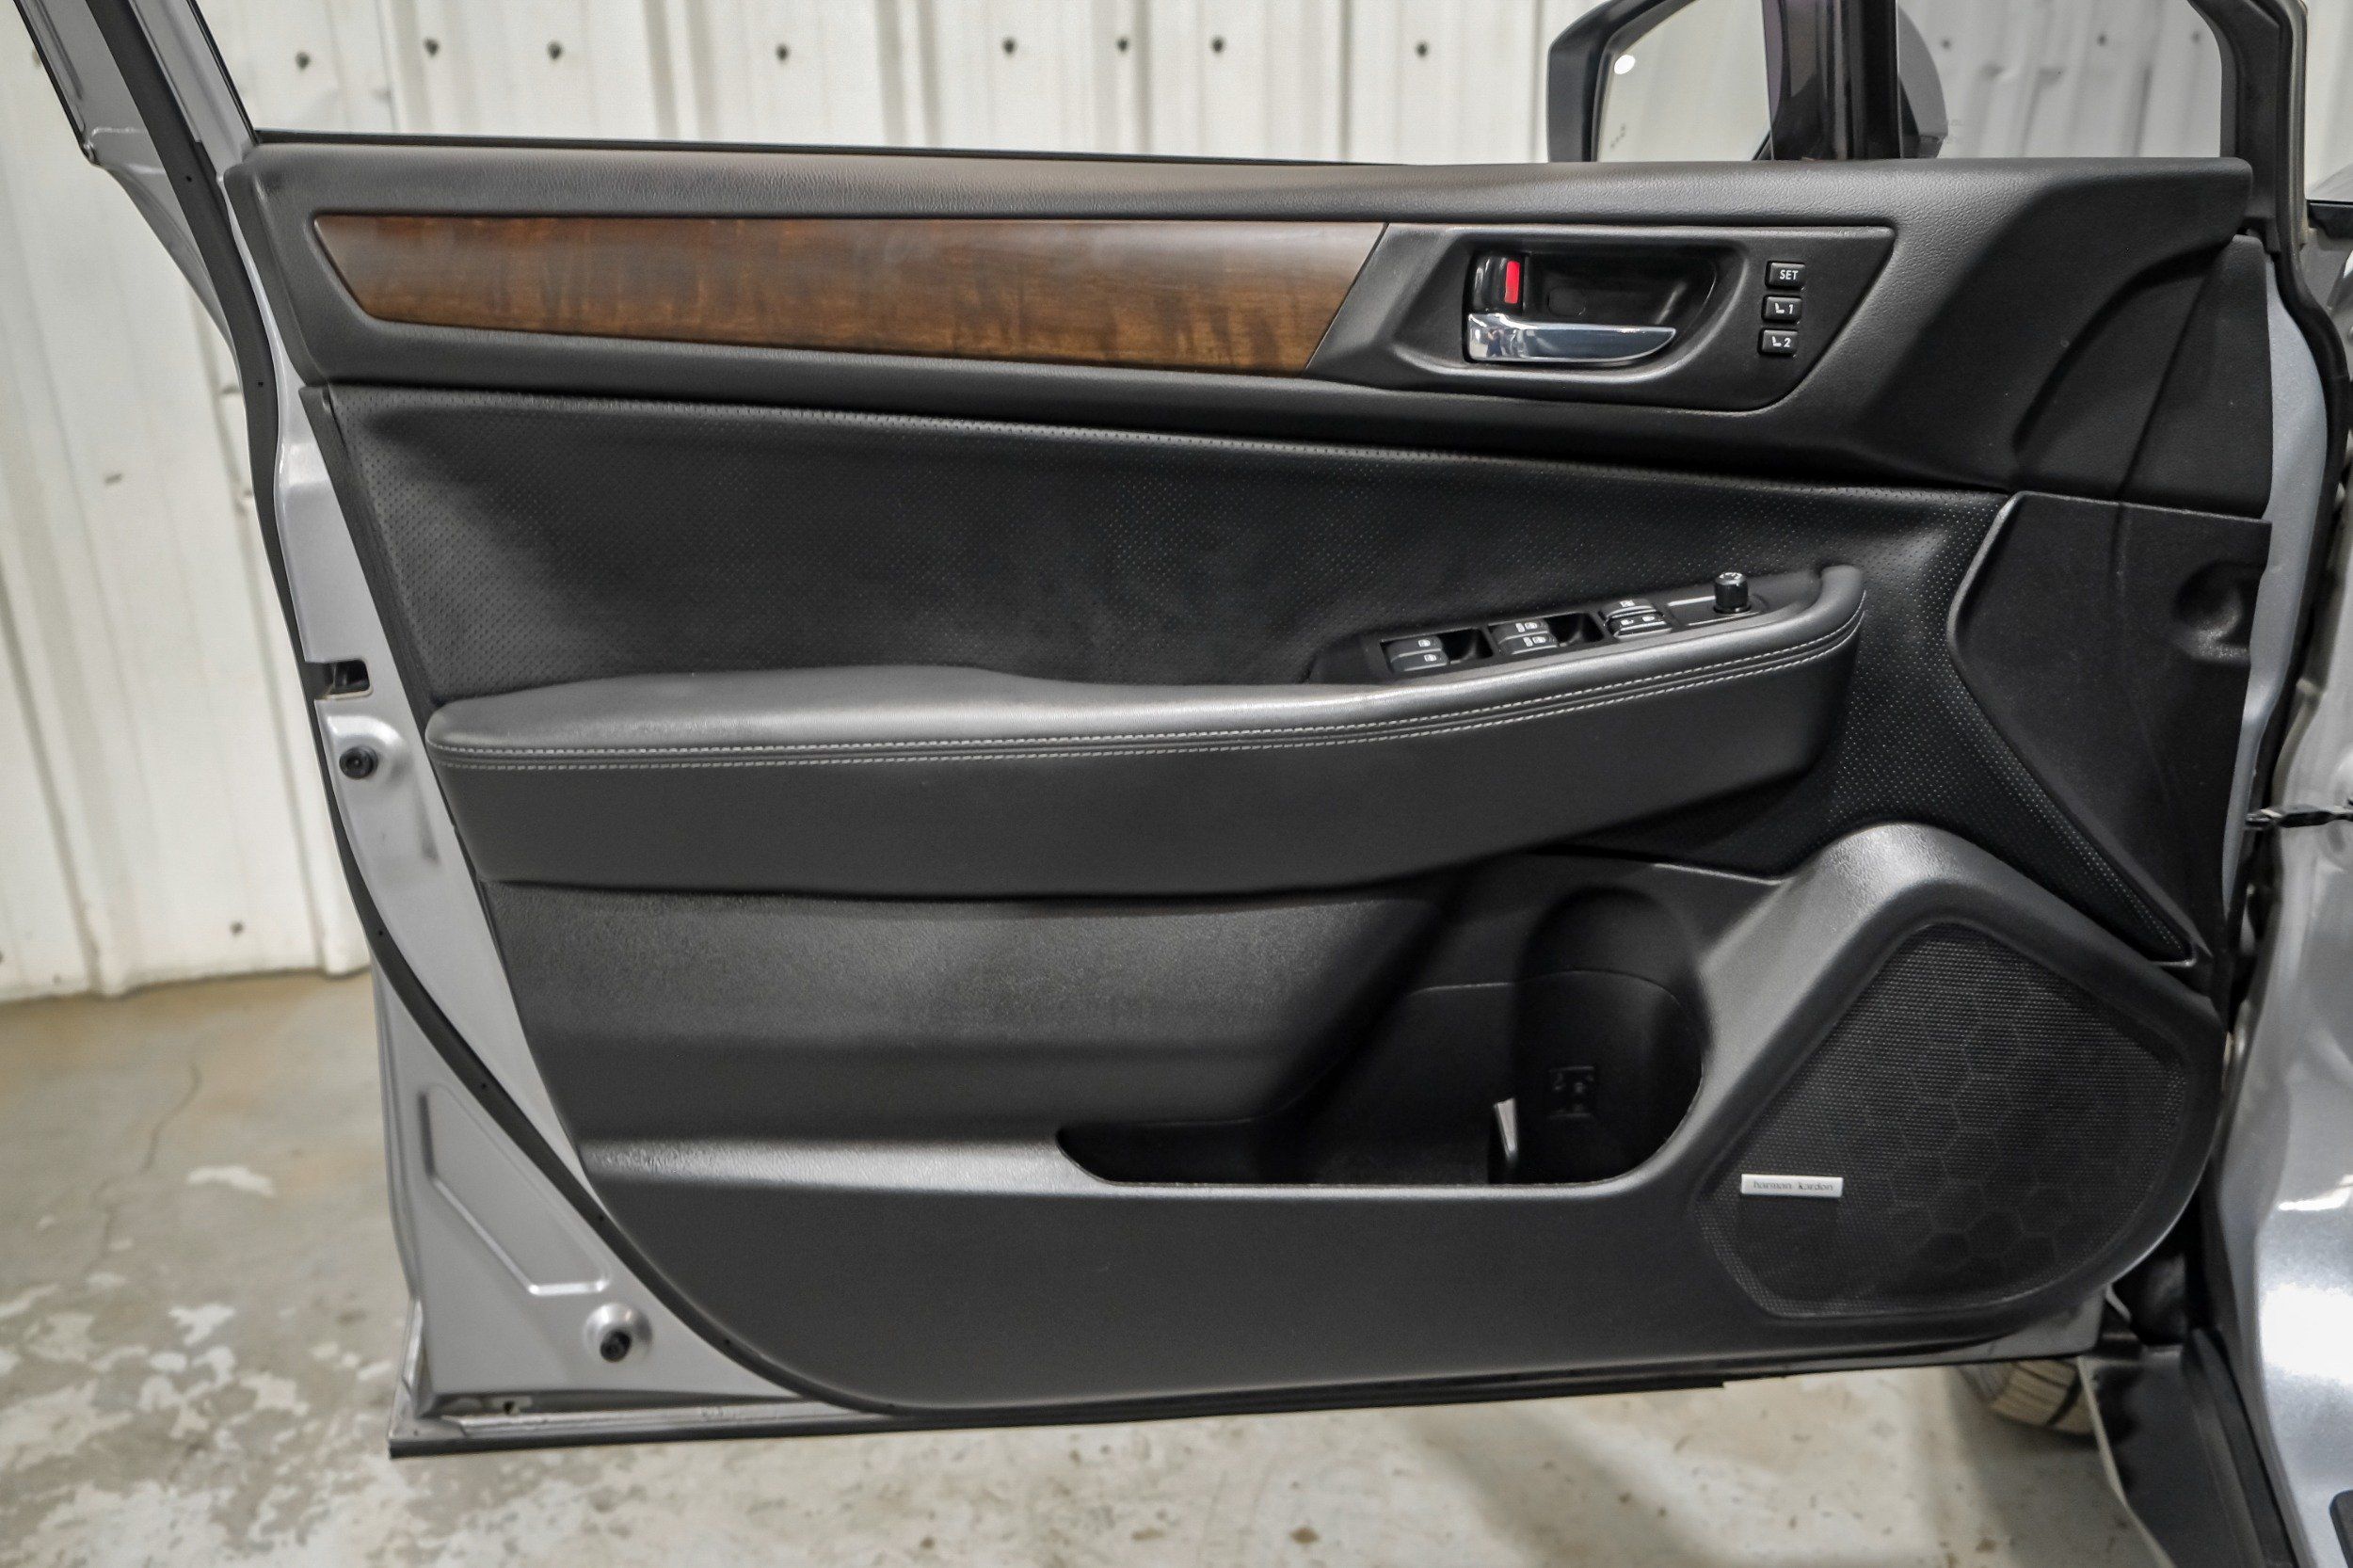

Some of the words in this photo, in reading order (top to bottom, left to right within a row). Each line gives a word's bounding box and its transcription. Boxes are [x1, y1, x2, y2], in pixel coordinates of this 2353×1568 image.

[1779, 269, 1799, 280] SET
[1784, 338, 1792, 347] 2
[1799, 1182, 1833, 1192] kardon
